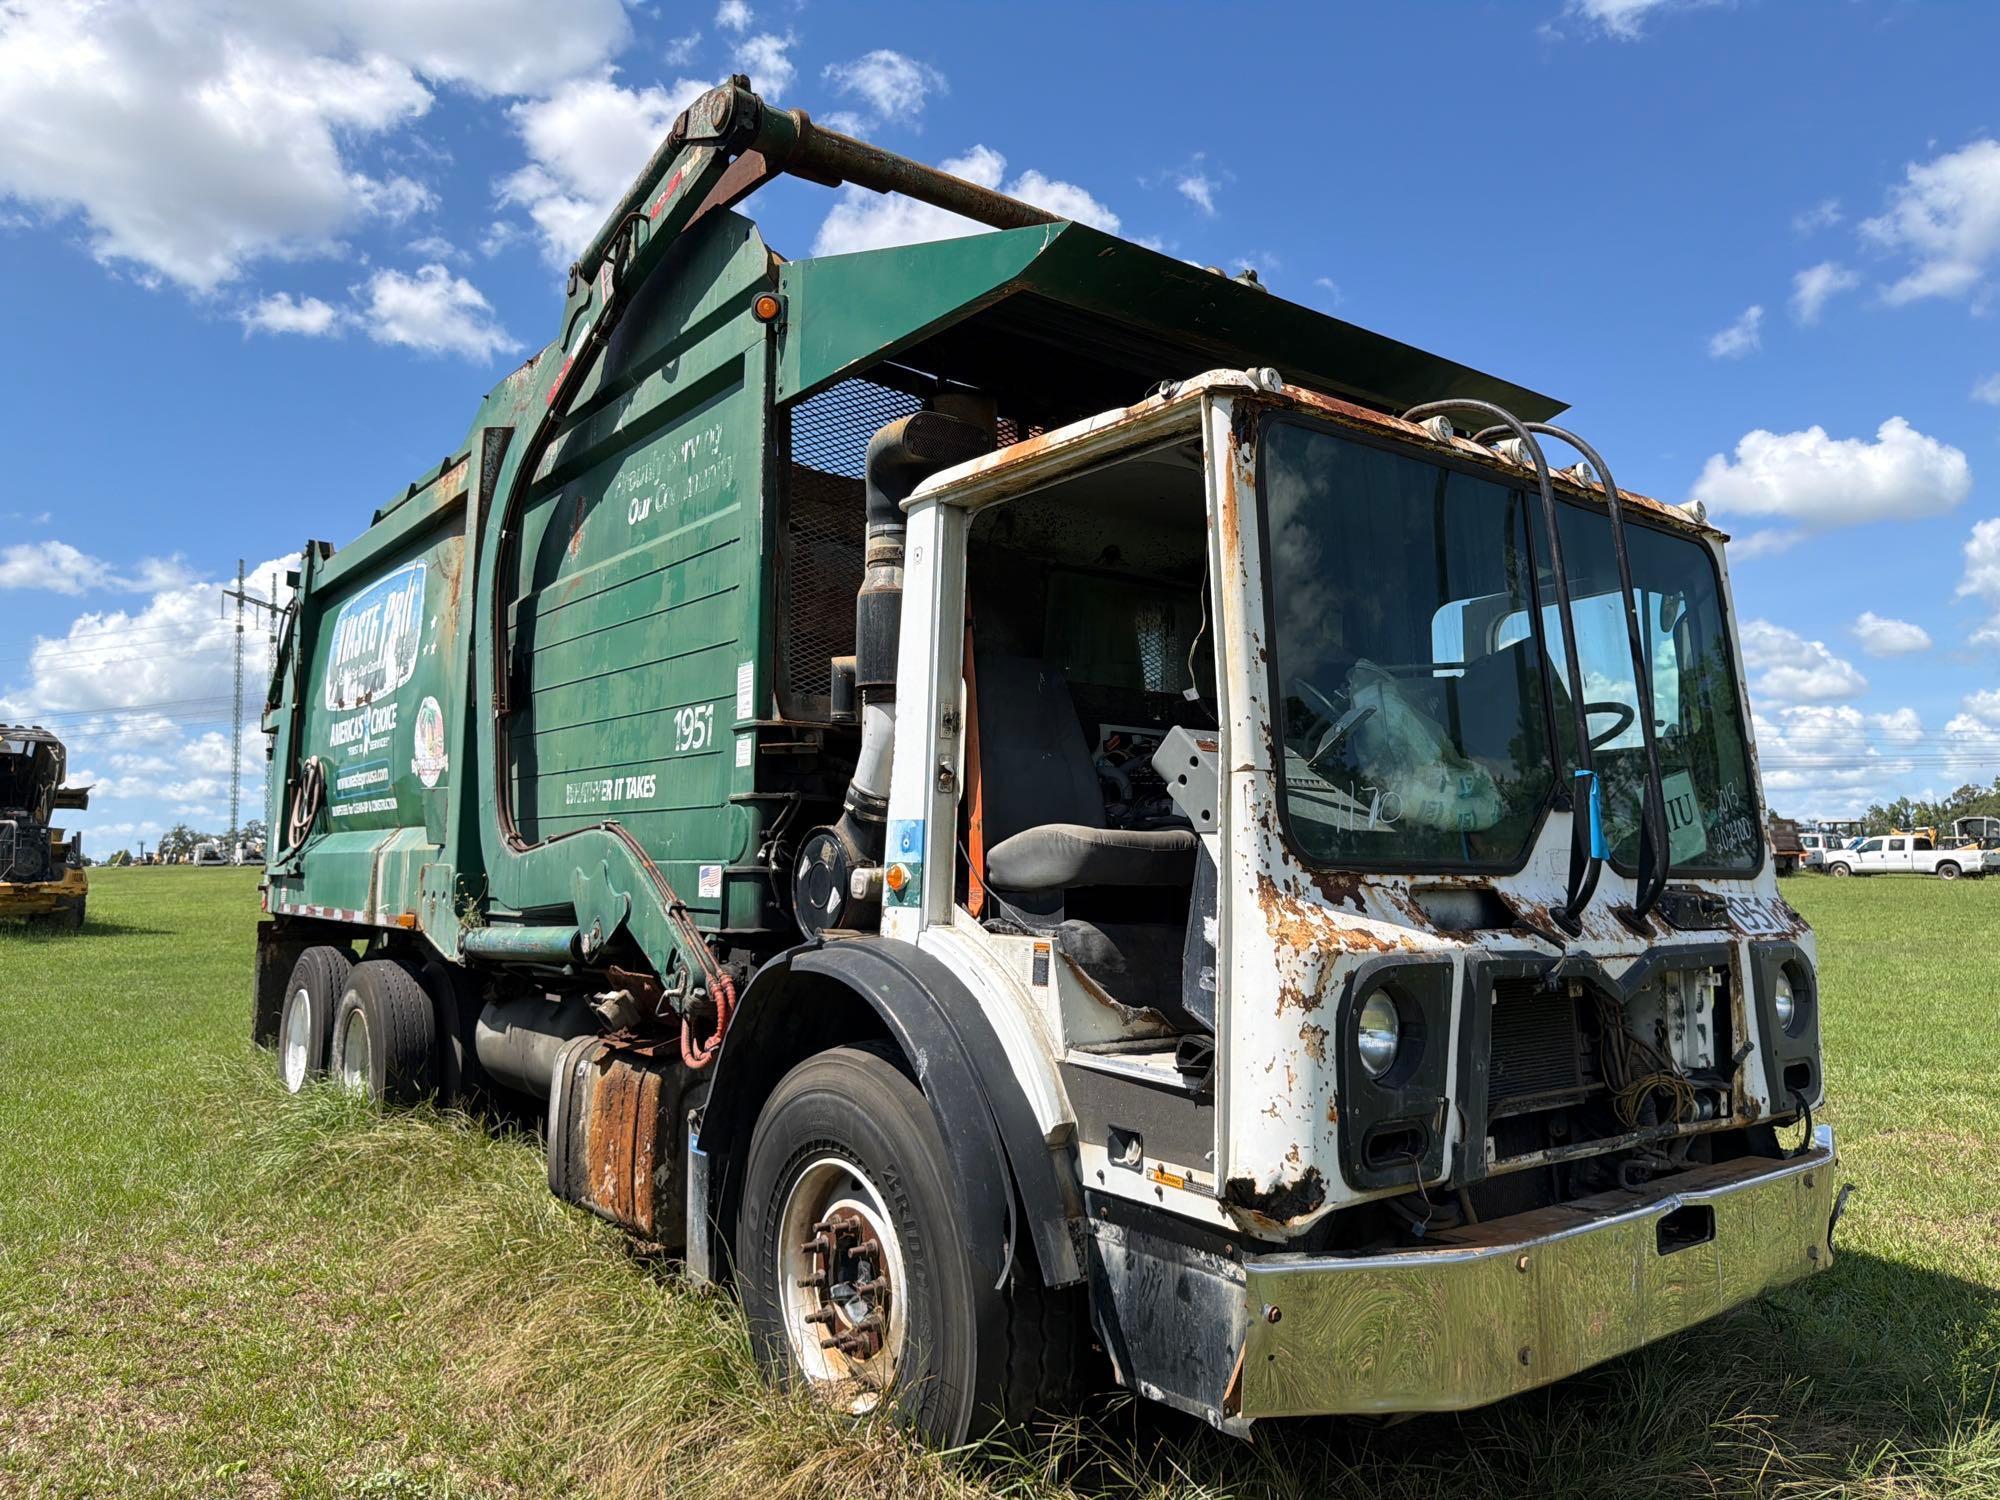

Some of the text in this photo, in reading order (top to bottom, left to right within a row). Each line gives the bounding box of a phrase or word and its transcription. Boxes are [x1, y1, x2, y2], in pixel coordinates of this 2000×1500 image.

[628, 496, 652, 525] Our
[370, 702, 398, 735] CHOICE
[673, 703, 714, 751] 1951
[614, 778, 625, 801] IT
[626, 774, 656, 800] TAKES
[1664, 793, 1693, 832] IU
